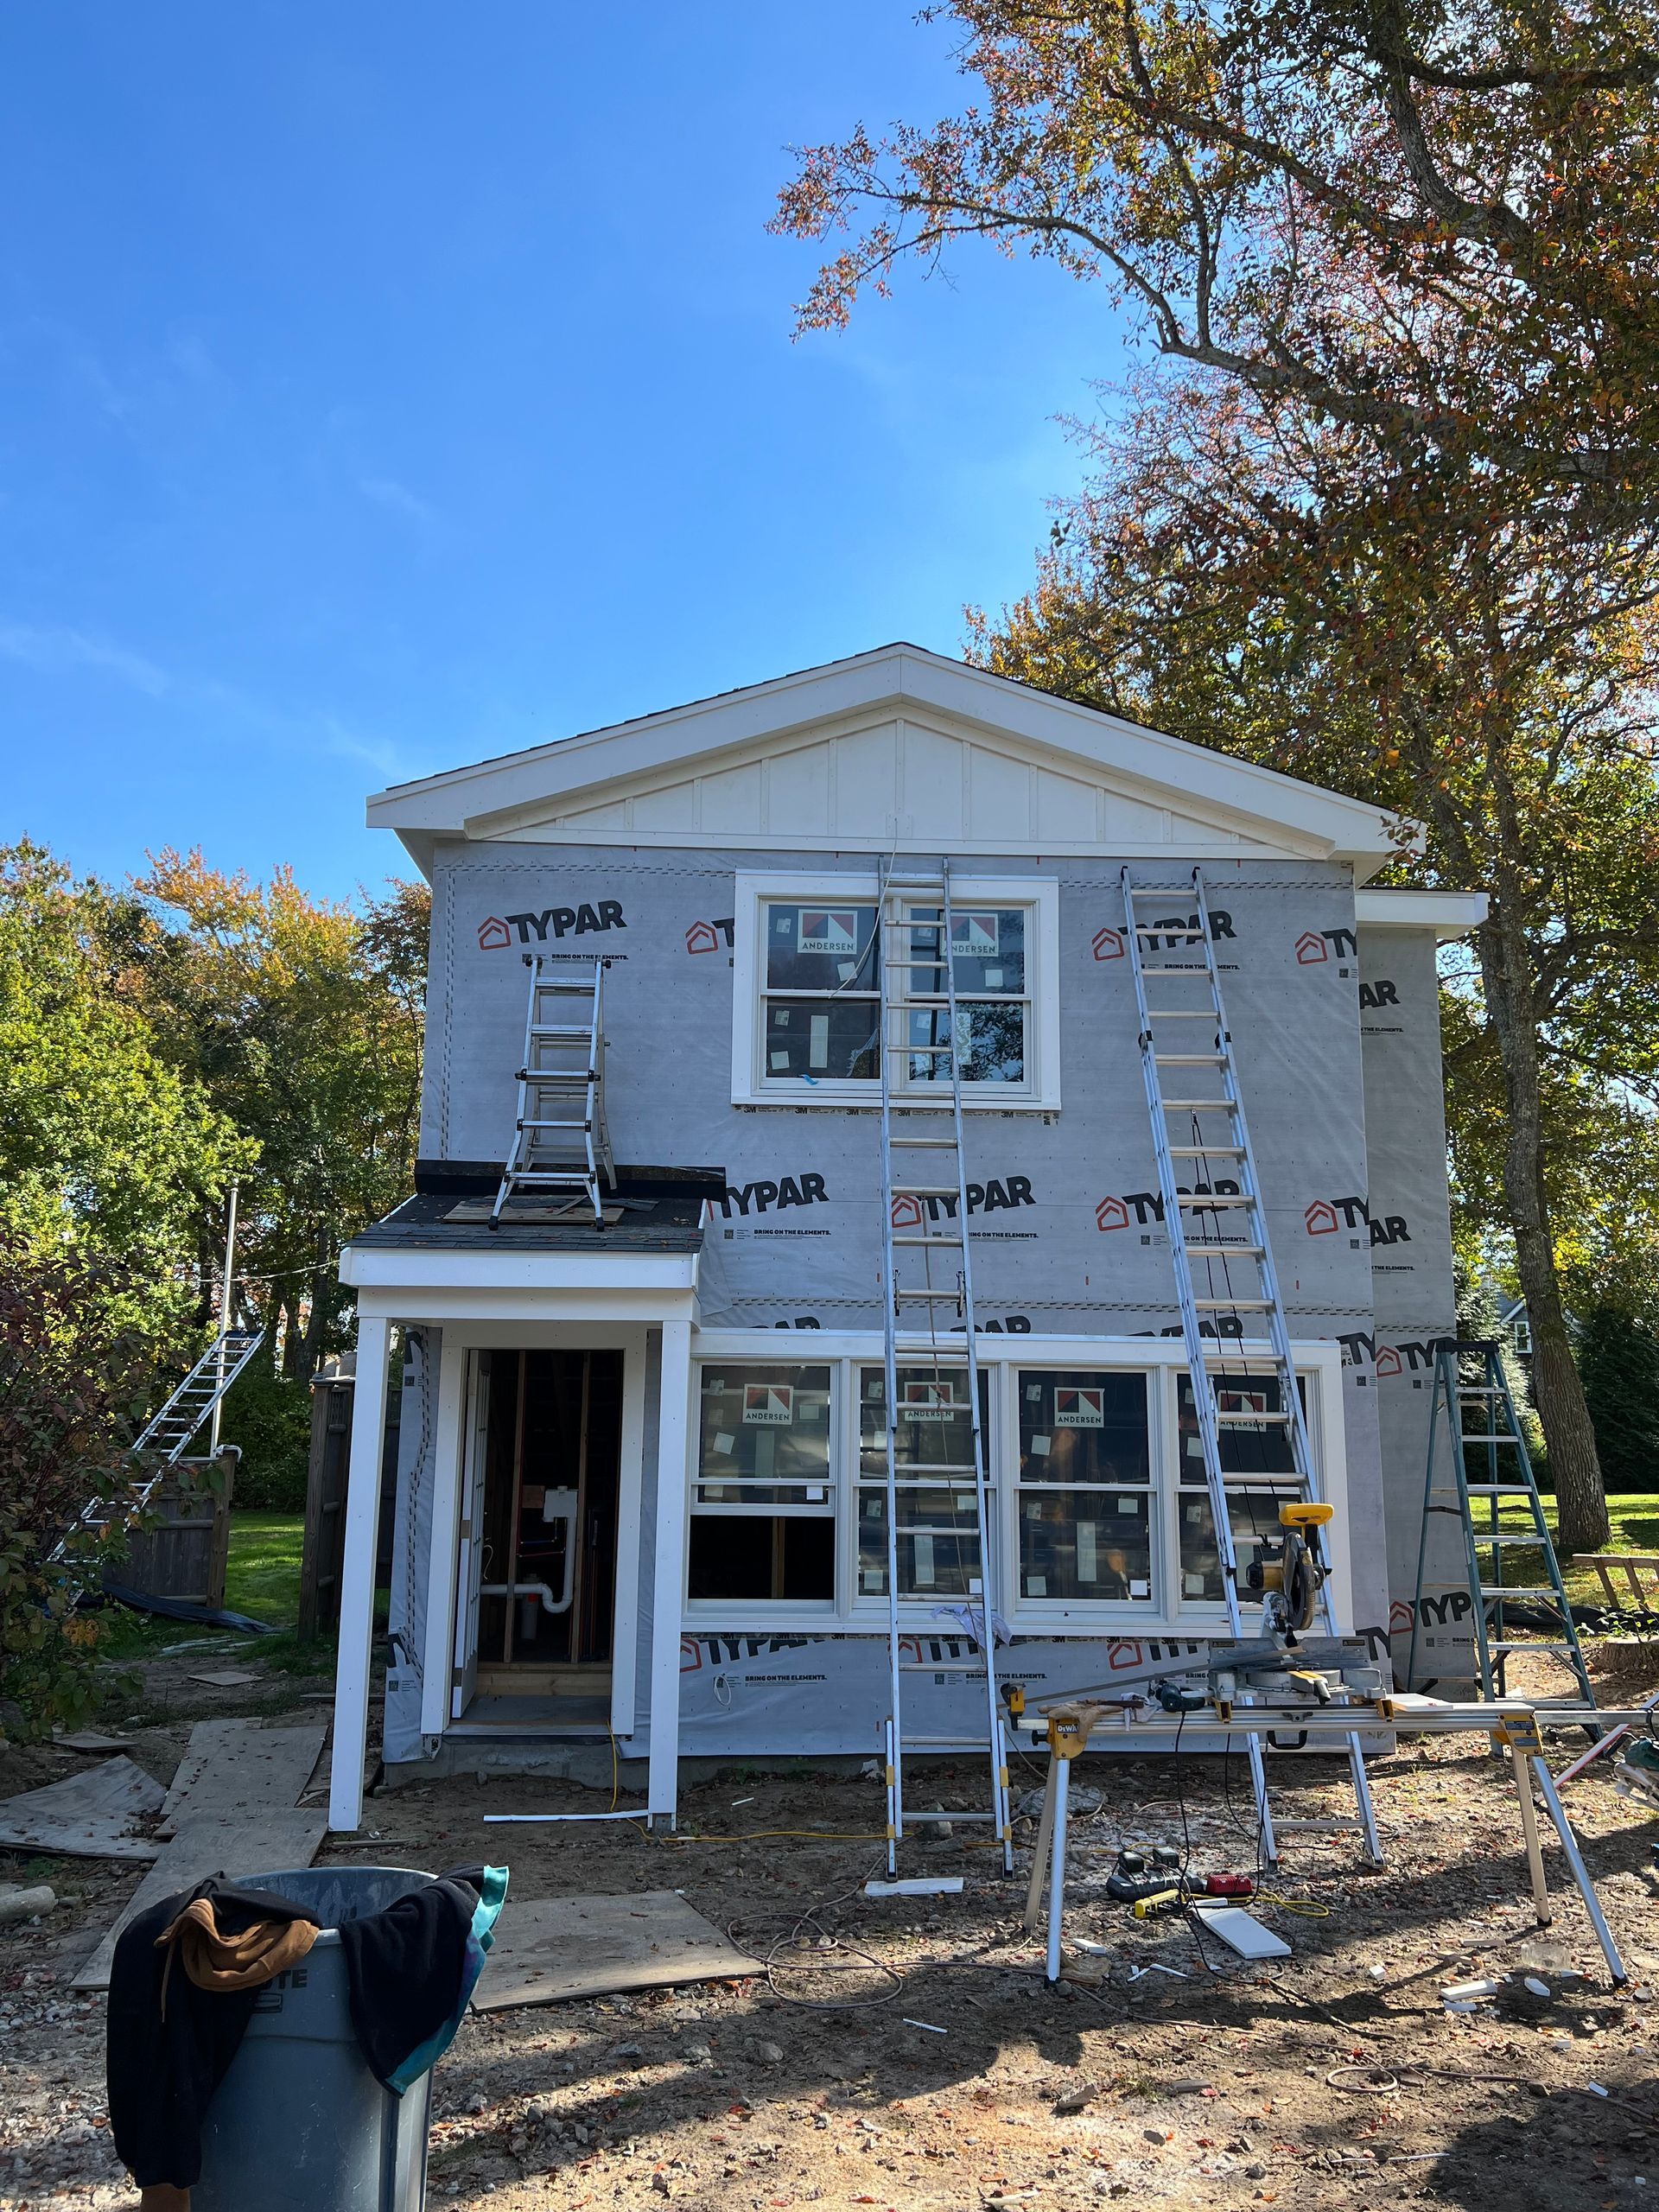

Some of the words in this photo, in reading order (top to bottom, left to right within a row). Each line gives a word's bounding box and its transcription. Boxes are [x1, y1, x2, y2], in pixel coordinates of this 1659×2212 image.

[505, 899, 627, 944] TYPAR
[802, 942, 854, 950] ANDERSEN
[745, 1412, 790, 1421] ANDERSEN
[1058, 1415, 1101, 1424] ANDERSEN
[1408, 1591, 1471, 1627] TYP
[1052, 1635, 1065, 1643] 3M
